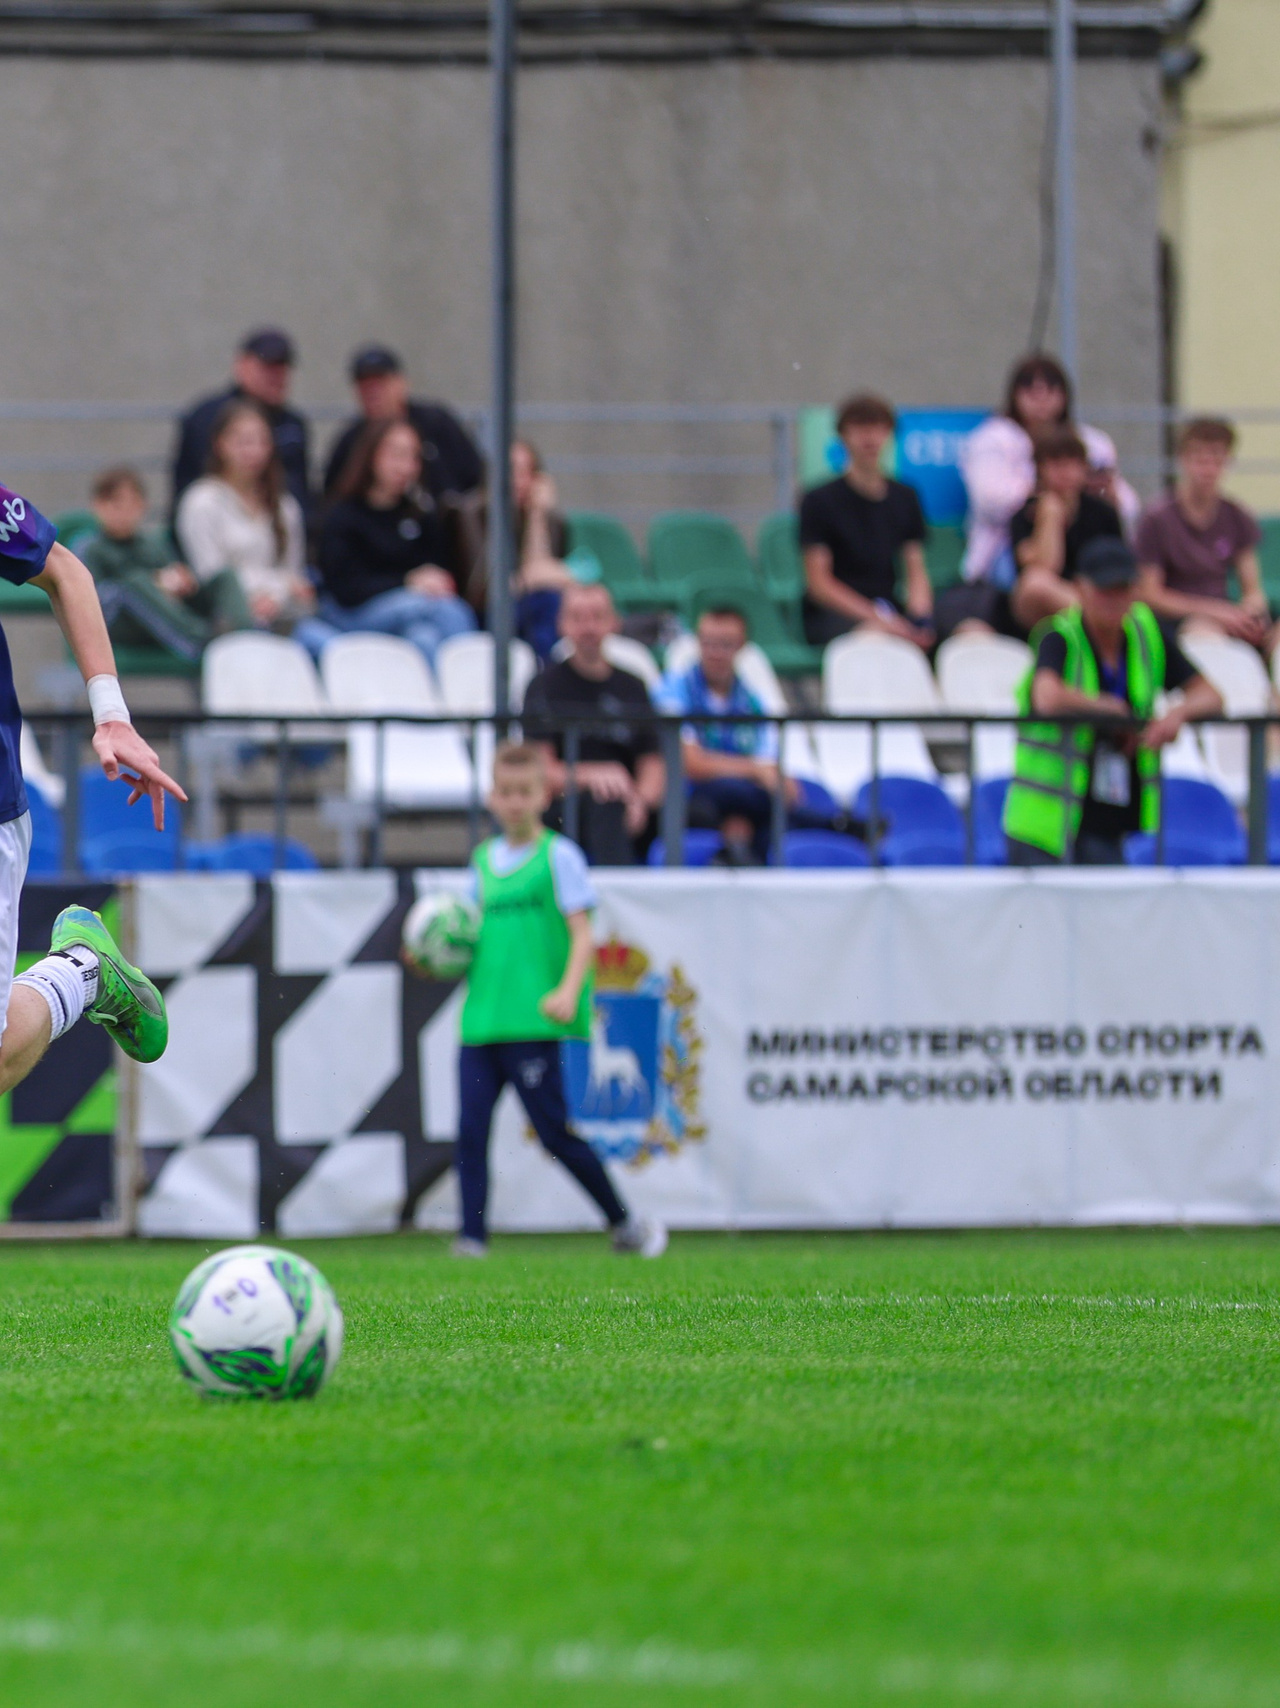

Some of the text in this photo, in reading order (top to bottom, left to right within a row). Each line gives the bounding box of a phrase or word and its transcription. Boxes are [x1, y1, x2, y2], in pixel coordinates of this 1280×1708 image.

[746, 1023, 1266, 1057] МИНИСТЕРСТВО СПОРТА
[746, 1067, 1223, 1102] САМАРСКОЙ ОБЛАСТИ
